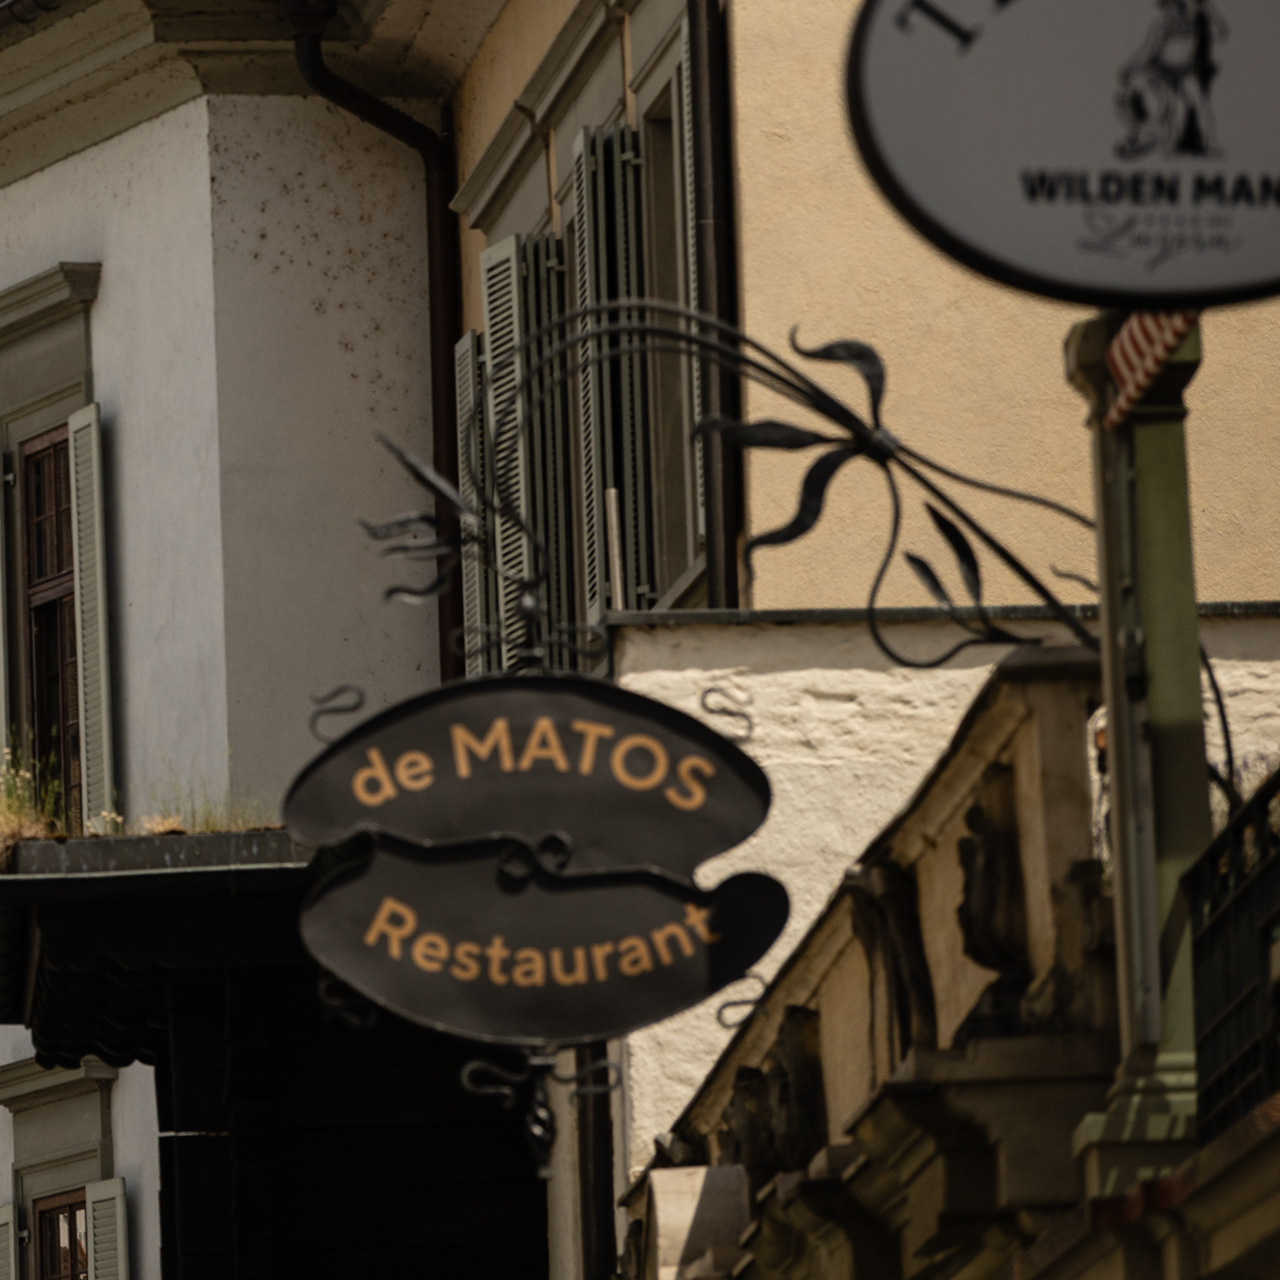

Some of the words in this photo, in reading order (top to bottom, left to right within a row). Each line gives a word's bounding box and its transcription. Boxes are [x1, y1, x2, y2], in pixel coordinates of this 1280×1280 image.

[1020, 168, 1181, 206] WILDEN
[351, 747, 435, 807] de
[449, 717, 716, 811] MATOS
[363, 897, 721, 987] Restaurant
